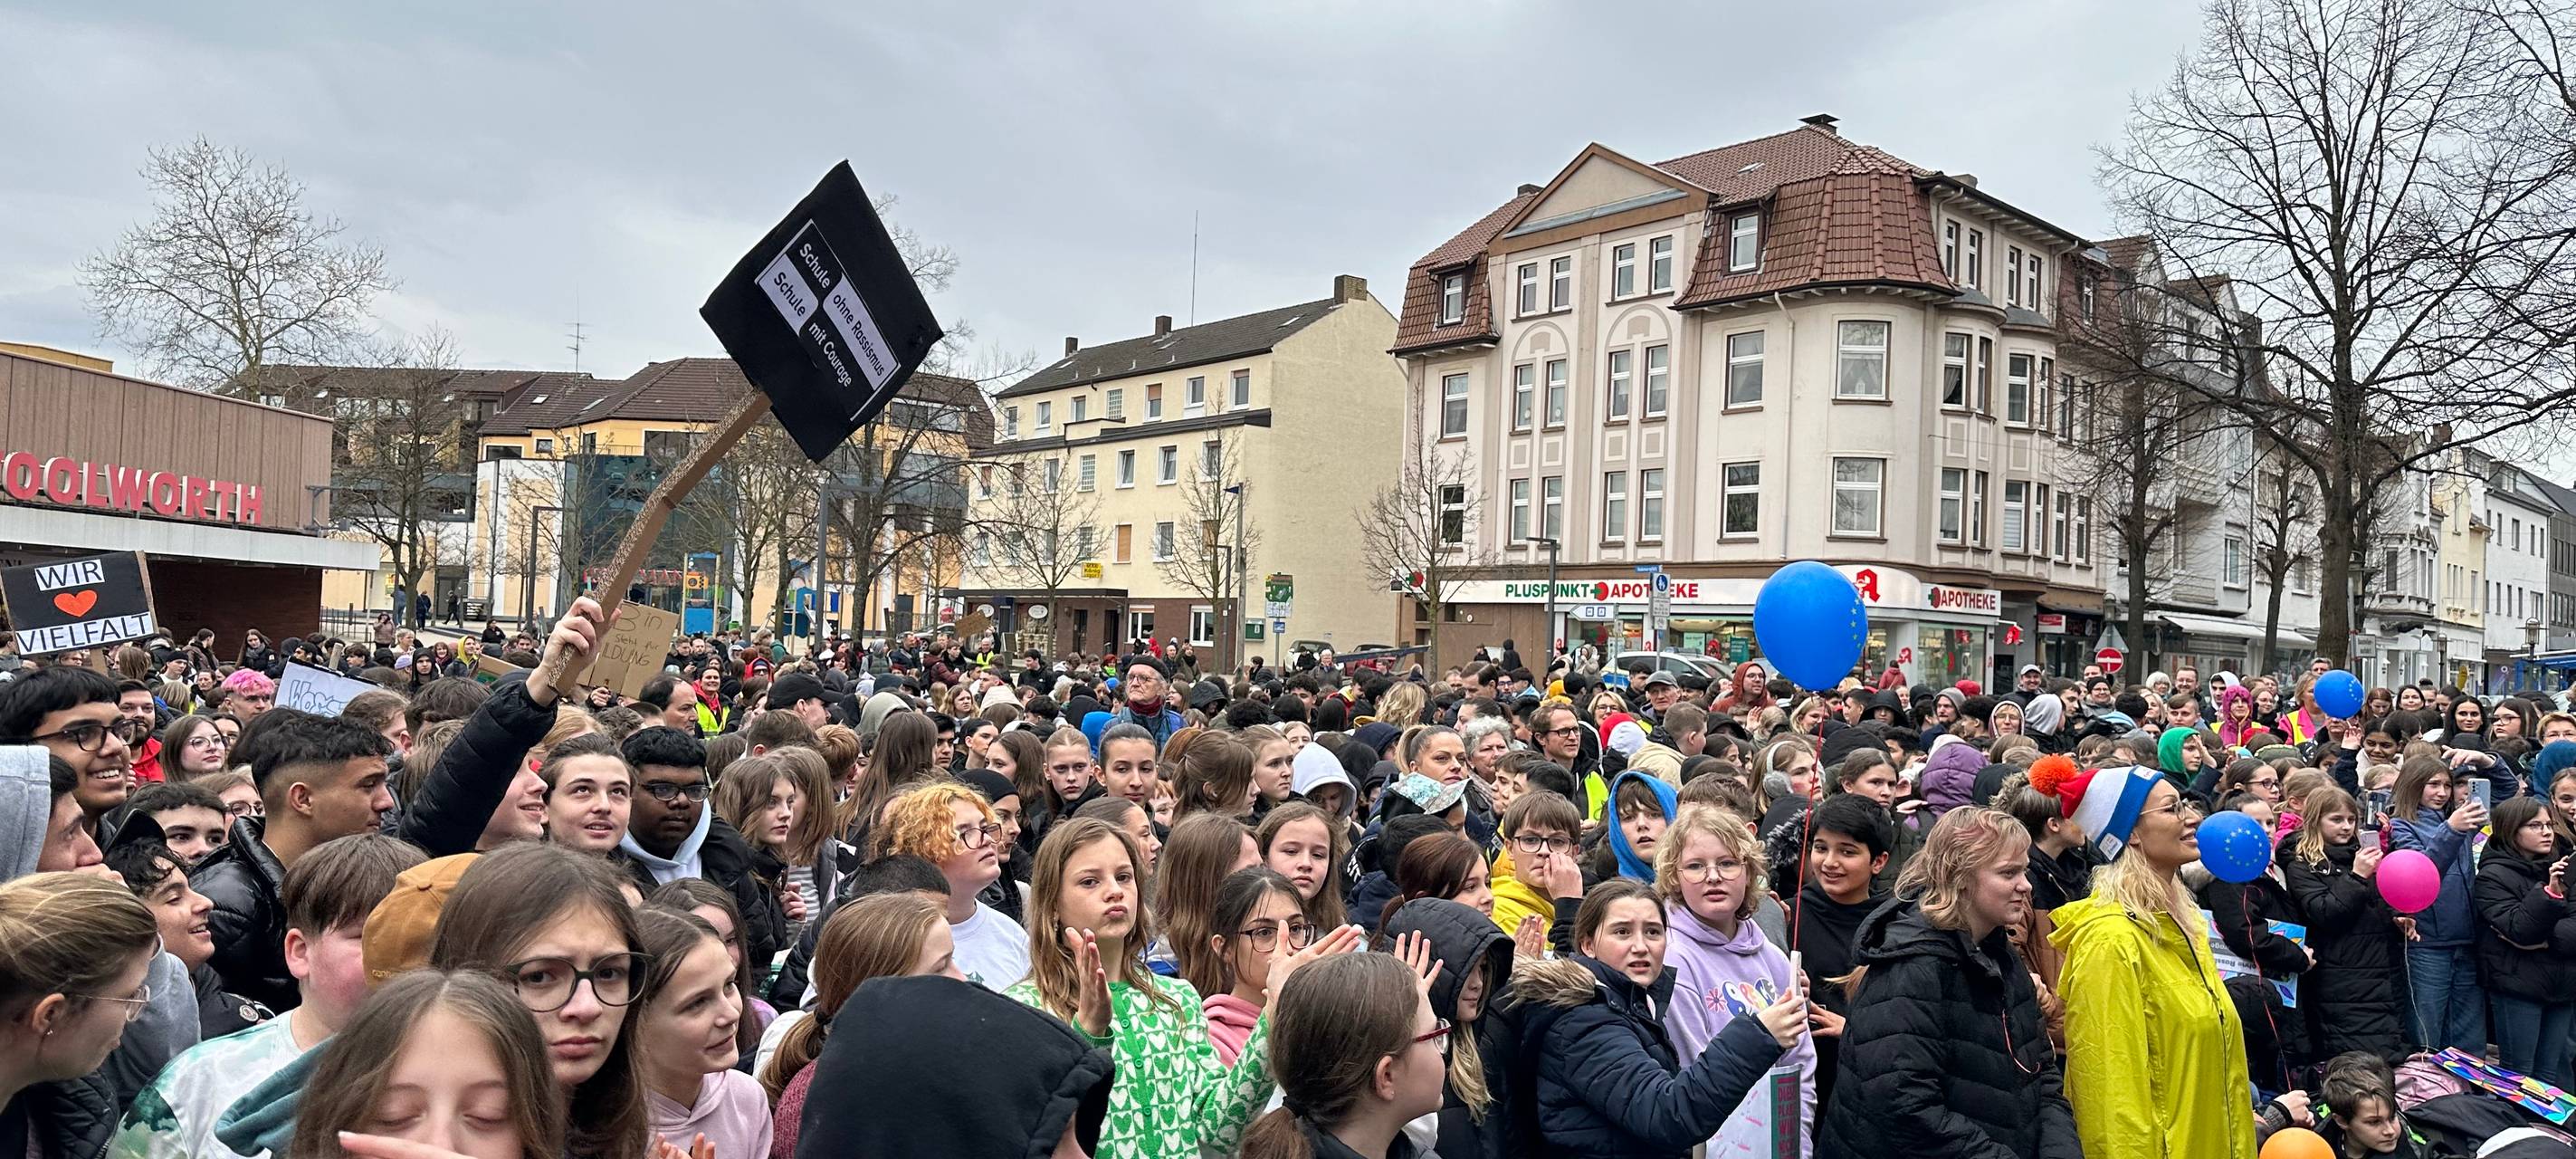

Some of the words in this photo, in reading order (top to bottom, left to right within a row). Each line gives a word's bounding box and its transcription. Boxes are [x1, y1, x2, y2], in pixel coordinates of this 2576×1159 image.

[800, 244, 830, 288] Schule
[774, 272, 806, 316] Schule
[808, 322, 826, 345] mit
[824, 341, 851, 387] Courage
[833, 295, 854, 324] ohne
[851, 321, 884, 376] Rassismus
[0, 451, 262, 525] OOLWORTH
[36, 560, 102, 589] WIR
[1610, 584, 1698, 598] APOTEKE
[1941, 589, 1996, 610] APOTHEKE
[16, 613, 149, 652] VIELFALT
